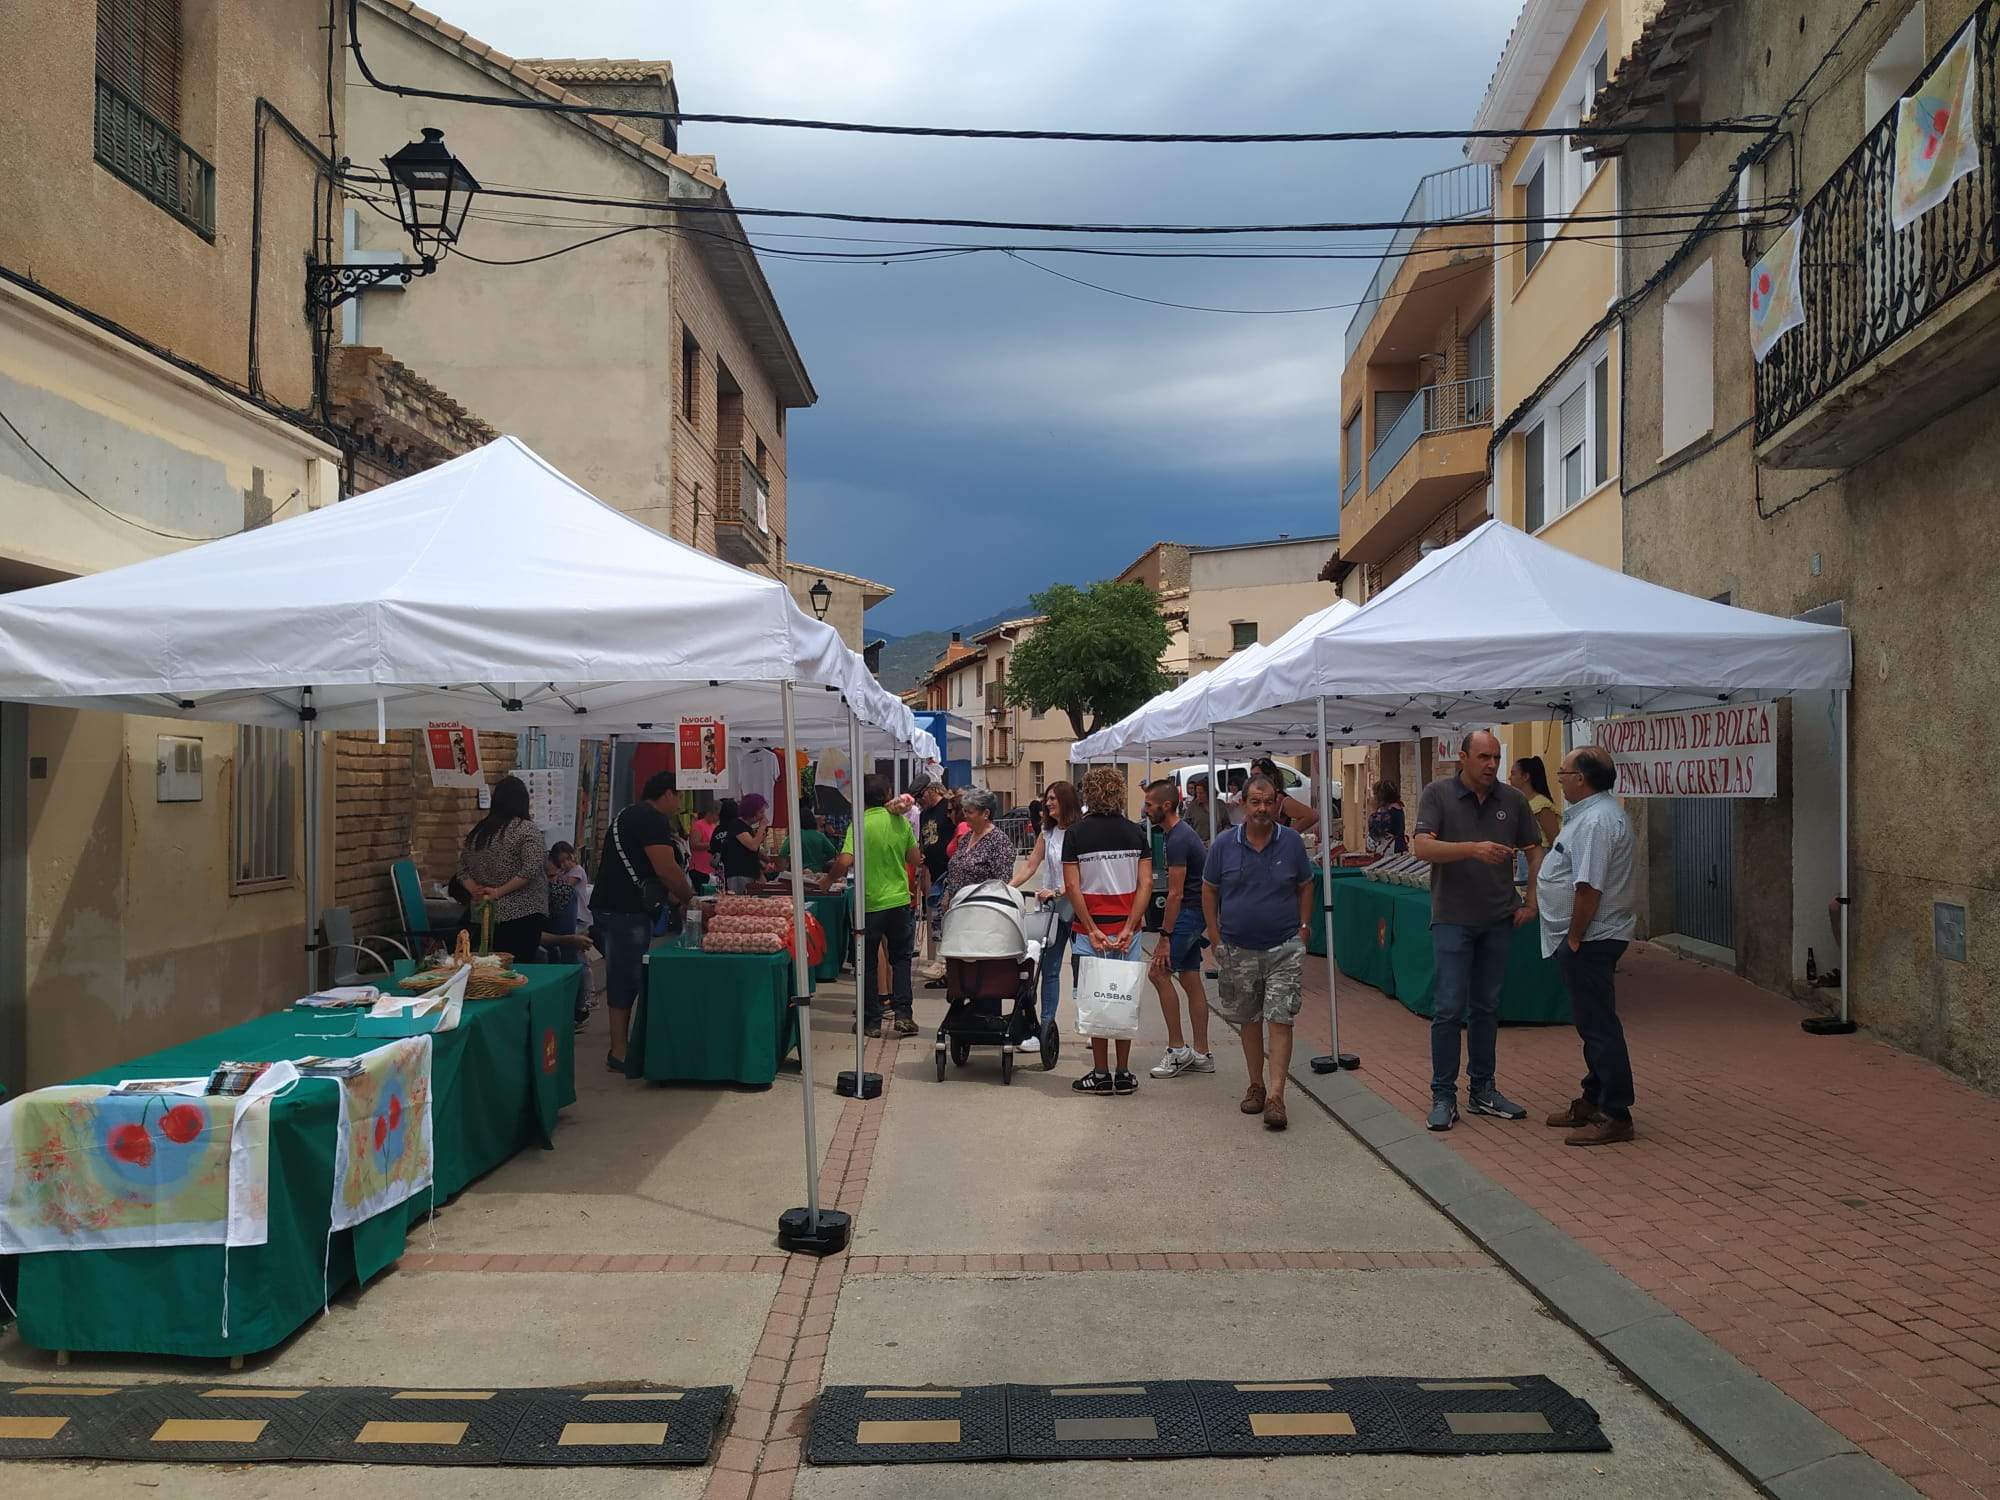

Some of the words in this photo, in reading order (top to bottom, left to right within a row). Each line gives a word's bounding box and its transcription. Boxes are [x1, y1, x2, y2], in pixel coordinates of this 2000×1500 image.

[1596, 714, 1687, 754] COOPERATIVA
[1691, 712, 1711, 748] DE
[1714, 705, 1771, 748] BOLEA
[1615, 762, 1651, 795] ENTA
[1654, 761, 1673, 795] DE
[1676, 755, 1754, 795] CEREZAS
[1093, 991, 1132, 1001] CASBAS
